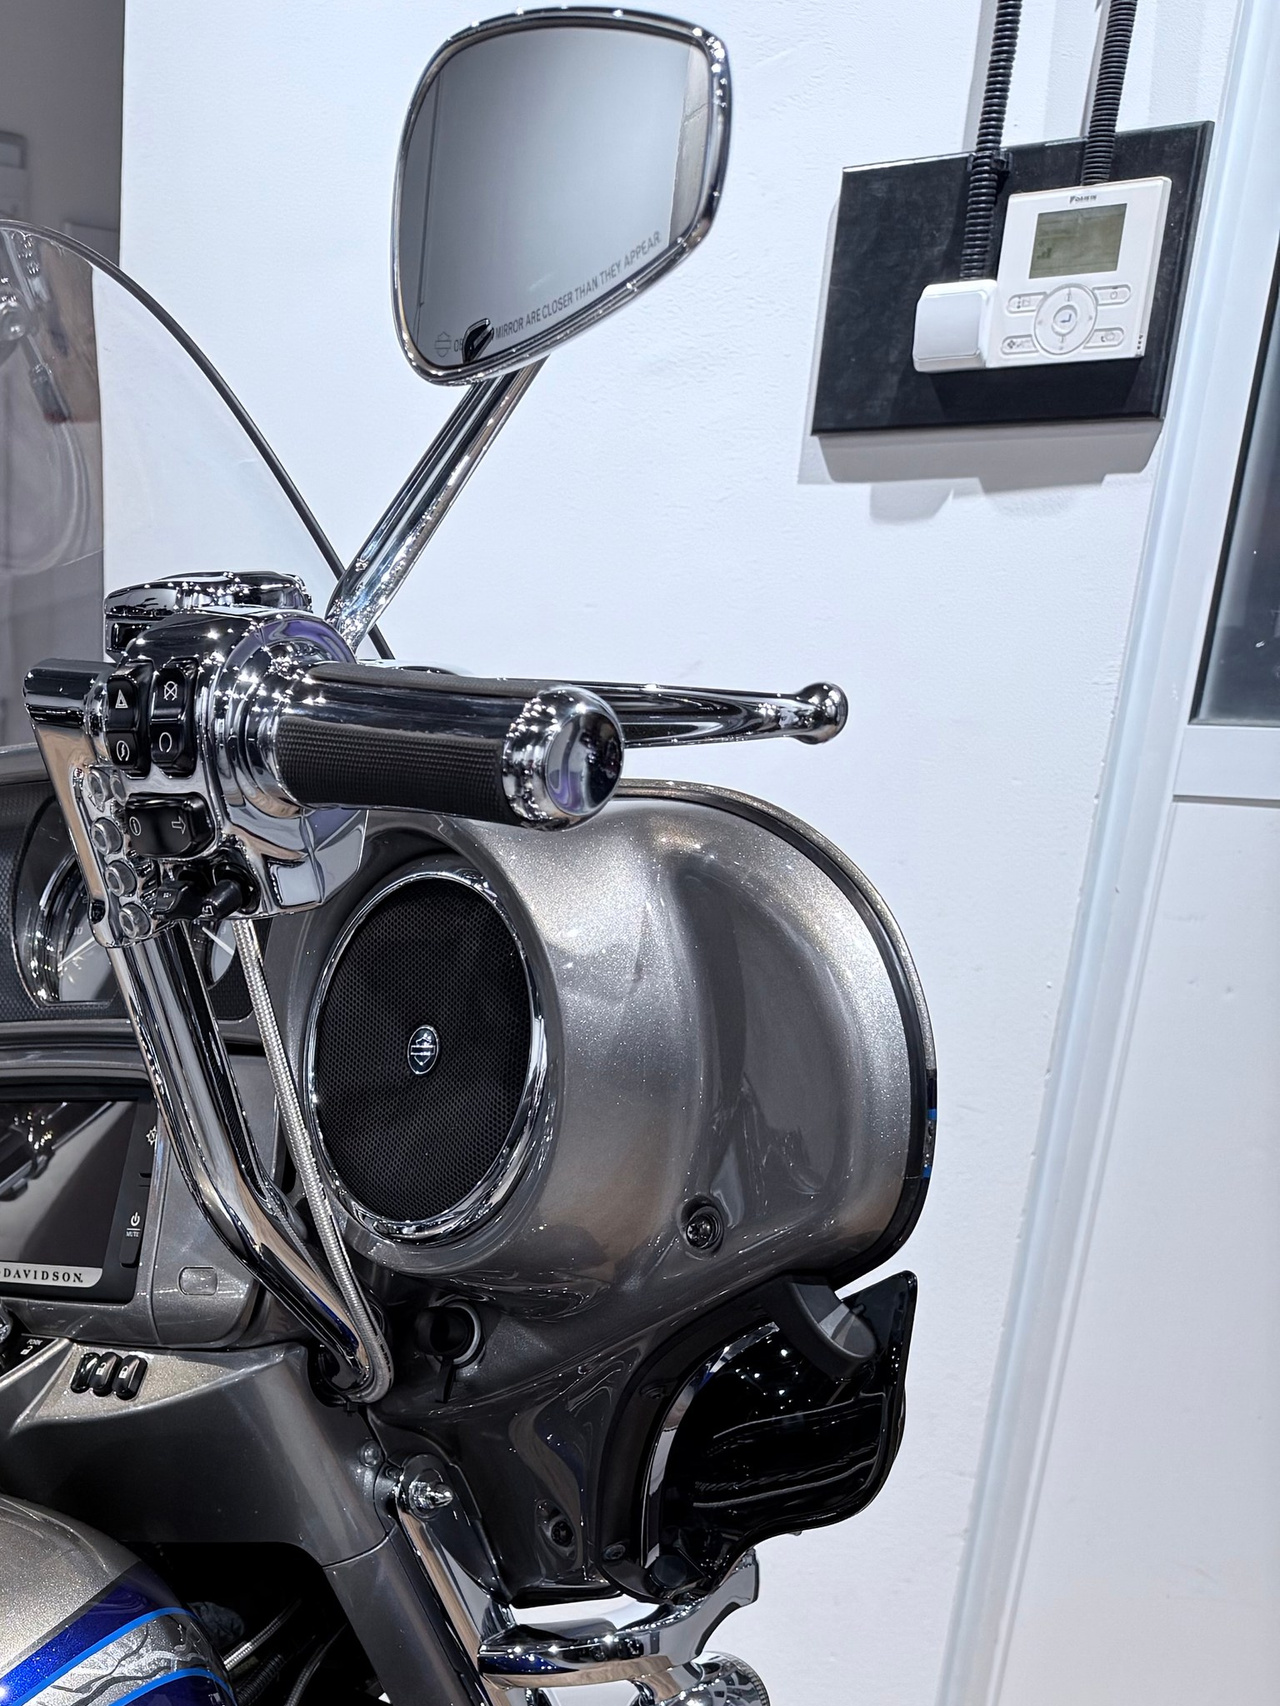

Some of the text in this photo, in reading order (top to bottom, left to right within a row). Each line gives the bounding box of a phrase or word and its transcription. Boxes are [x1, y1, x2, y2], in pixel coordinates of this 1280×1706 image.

[495, 231, 661, 340] MIRROR ARE CLOSER THAN THEY APPEAR
